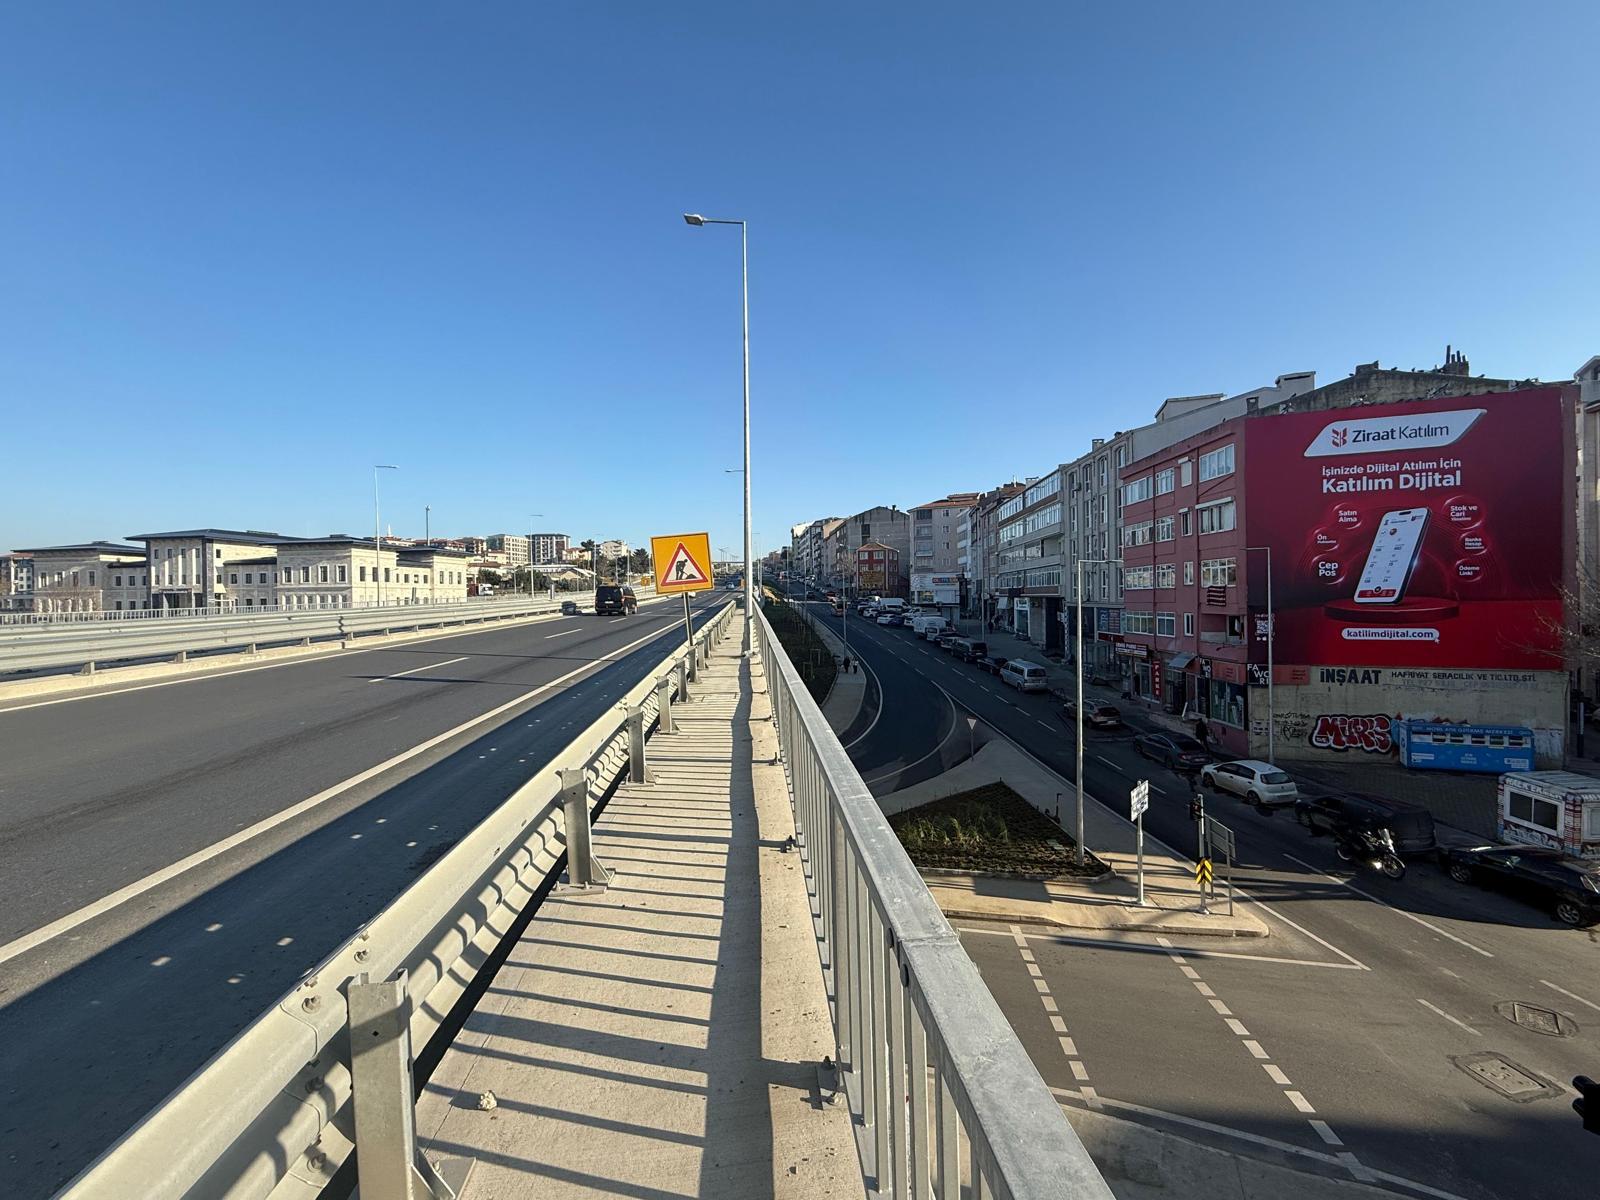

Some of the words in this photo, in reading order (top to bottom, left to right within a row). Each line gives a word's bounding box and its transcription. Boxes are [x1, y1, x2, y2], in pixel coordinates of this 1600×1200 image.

[1352, 428, 1396, 443] Ziraat
[1399, 424, 1449, 440] Katılım
[1322, 465, 1364, 477] İşinizde
[1366, 463, 1399, 475] Dijital
[1402, 461, 1437, 471] Atılım
[1440, 457, 1461, 470] İçin
[1322, 476, 1393, 494] Katılım
[1399, 470, 1461, 491] Dijital
[1318, 561, 1338, 570] Cep
[1319, 569, 1336, 577] Pos
[1347, 629, 1434, 639] katilimdijital.com
[1247, 663, 1259, 671] FA
